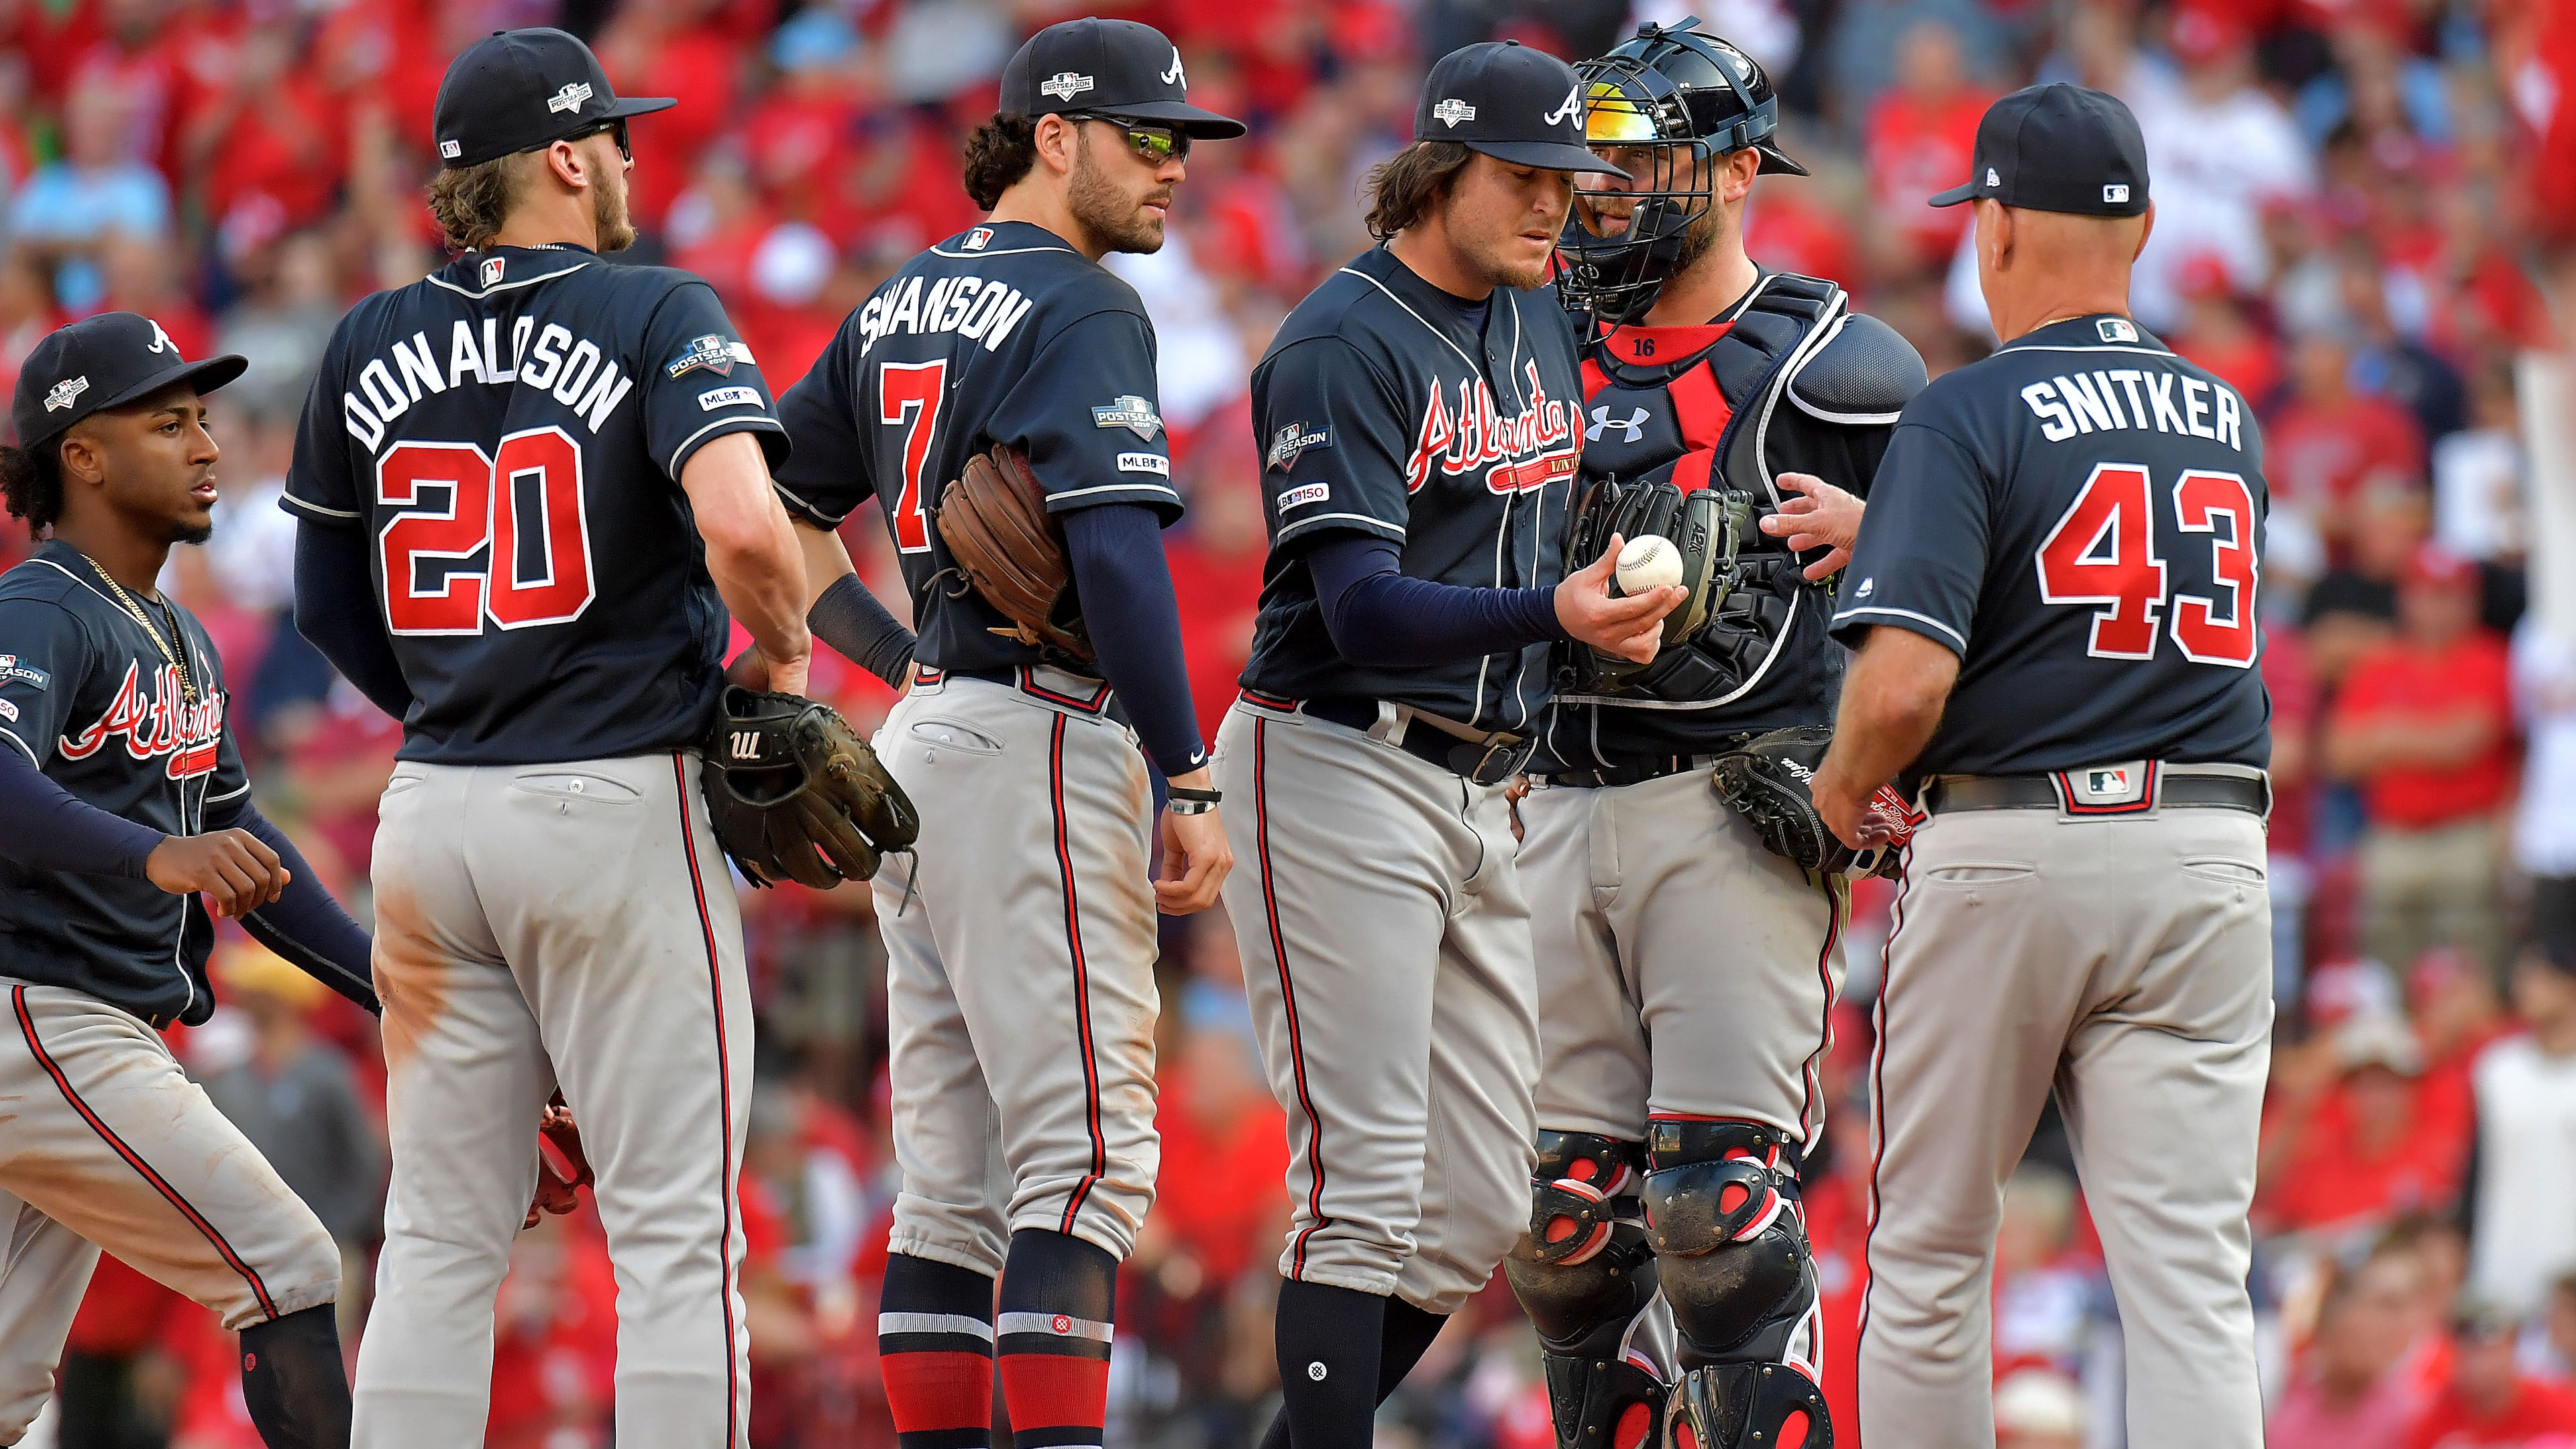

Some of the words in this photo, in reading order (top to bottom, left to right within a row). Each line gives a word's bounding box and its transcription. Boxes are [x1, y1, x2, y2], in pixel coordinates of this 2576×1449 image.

[1160, 46, 1187, 91] A
[550, 88, 590, 108] POSTSEASON
[1043, 81, 1090, 91] POSTSEASON
[1544, 84, 1583, 131] A
[859, 276, 1033, 358] SWANSON
[147, 319, 180, 354] A
[1633, 338, 1655, 357] 16
[669, 347, 740, 374] POSTSEAS
[708, 357, 727, 366] 2019
[47, 380, 85, 407] POSTSEASON
[704, 392, 733, 406] MLB
[1097, 412, 1164, 428] POSTSEAS
[2021, 369, 2241, 451] SNITKER
[1407, 357, 1569, 495] Atlanta
[879, 358, 948, 554] 7
[1269, 432, 1326, 458] STSEASON
[1282, 449, 1297, 459] 2019
[1123, 457, 1150, 468] MLB
[1301, 488, 1324, 499] 150
[376, 425, 596, 636] 20
[1688, 521, 1706, 557] A2K
[2035, 462, 2258, 669] 43
